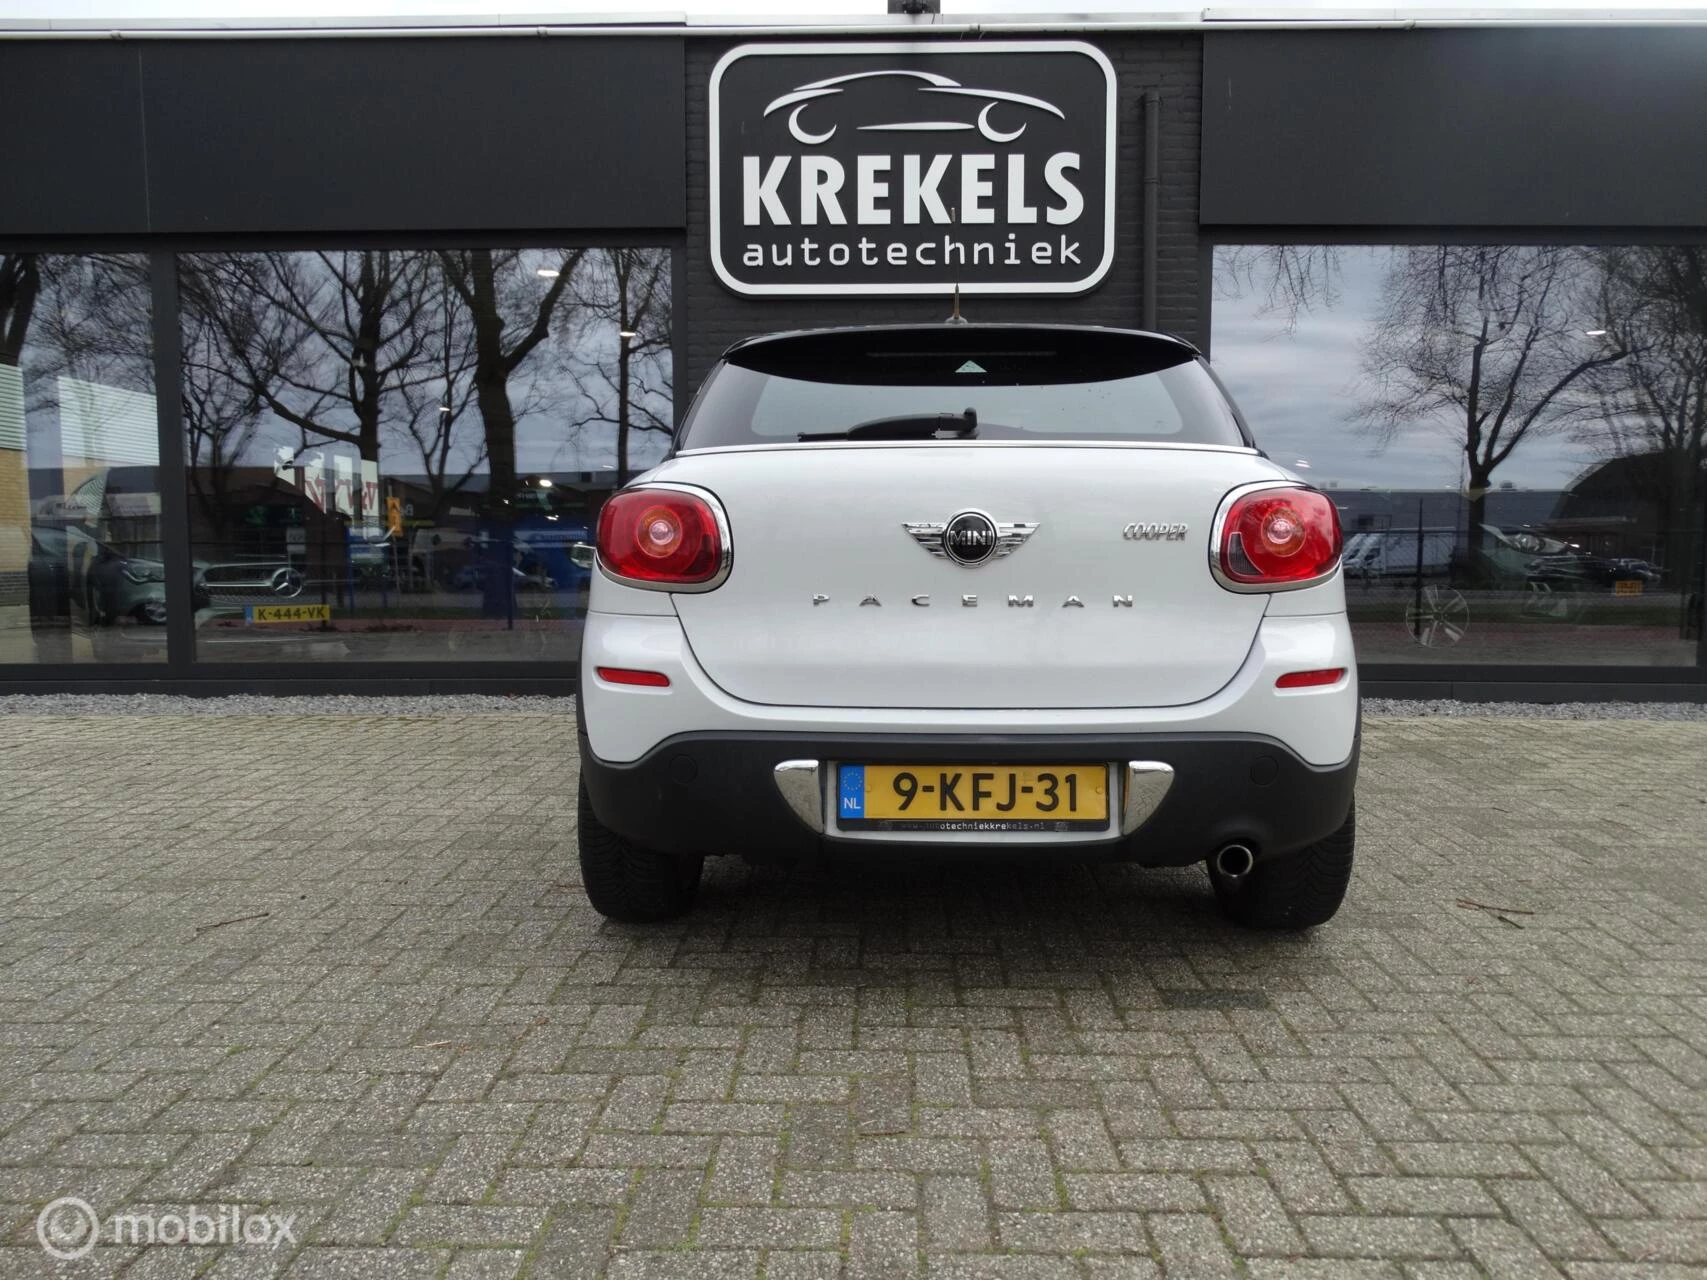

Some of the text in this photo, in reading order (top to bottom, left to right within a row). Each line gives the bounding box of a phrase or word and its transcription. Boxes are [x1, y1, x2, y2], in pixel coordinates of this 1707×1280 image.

[742, 151, 1084, 226] KREKELS
[743, 233, 1081, 266] autotechniek
[950, 530, 992, 545] MINI
[1123, 522, 1188, 541] COOPER
[812, 593, 1133, 607] PACEMAN
[258, 606, 325, 620] K-444-VK
[892, 772, 1077, 813] 9-KFJ-31
[843, 797, 862, 809] NL
